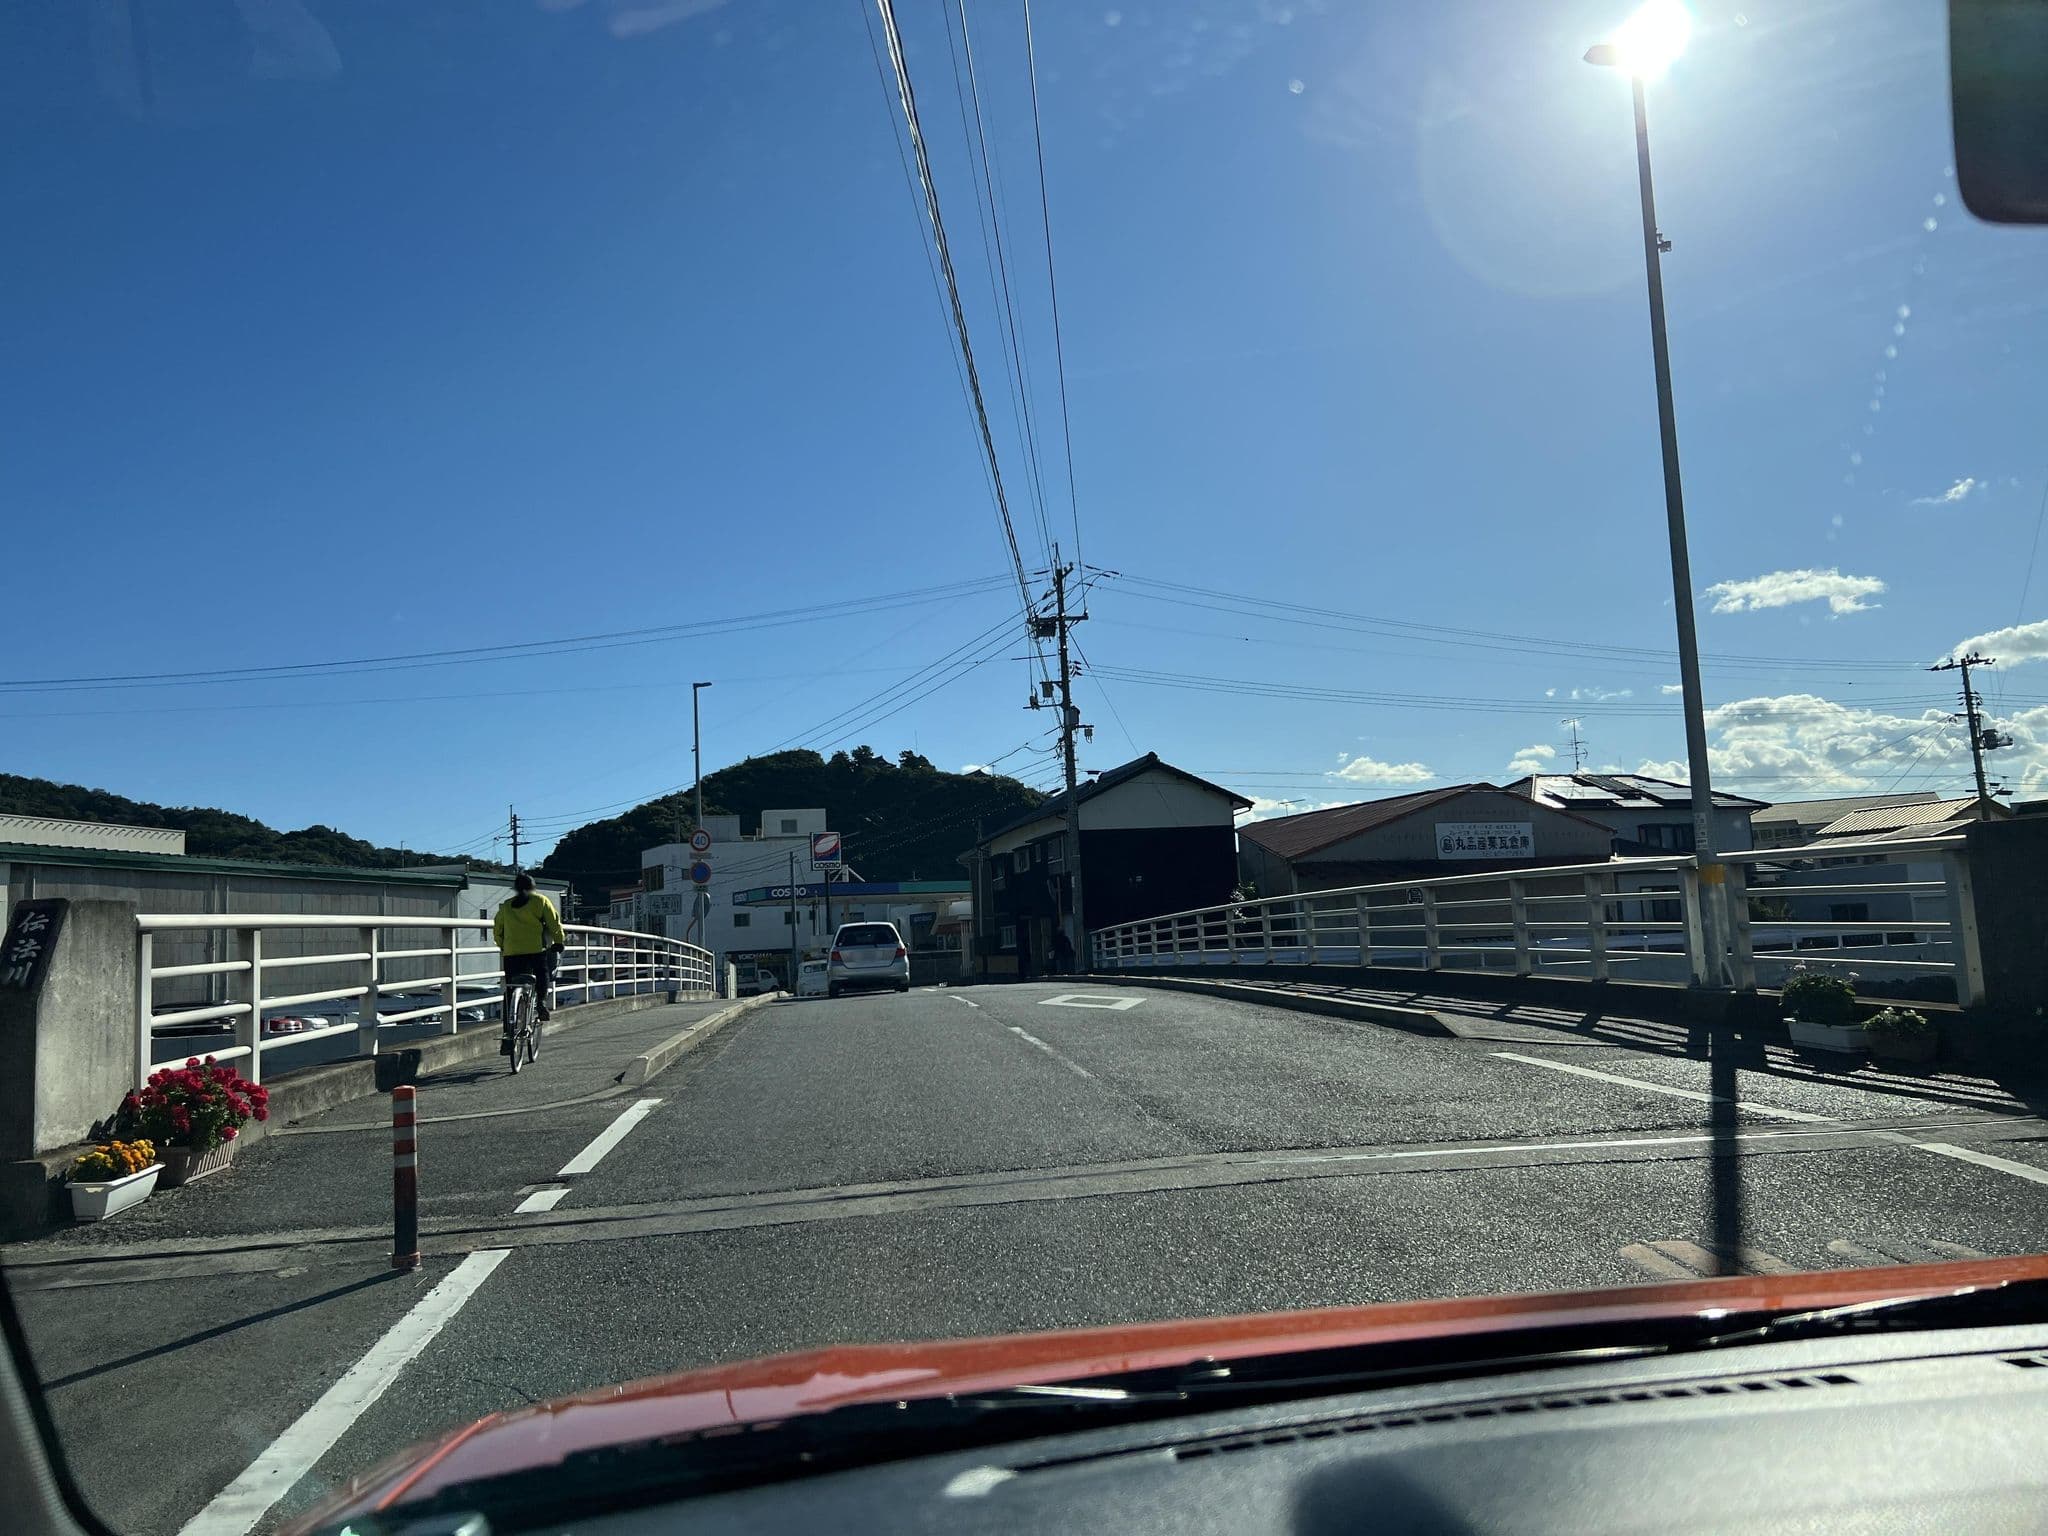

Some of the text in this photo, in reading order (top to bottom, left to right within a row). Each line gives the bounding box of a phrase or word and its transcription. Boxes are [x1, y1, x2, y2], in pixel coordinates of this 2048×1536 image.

[695, 836, 706, 846] 40
[6, 911, 50, 984] 伝法川
